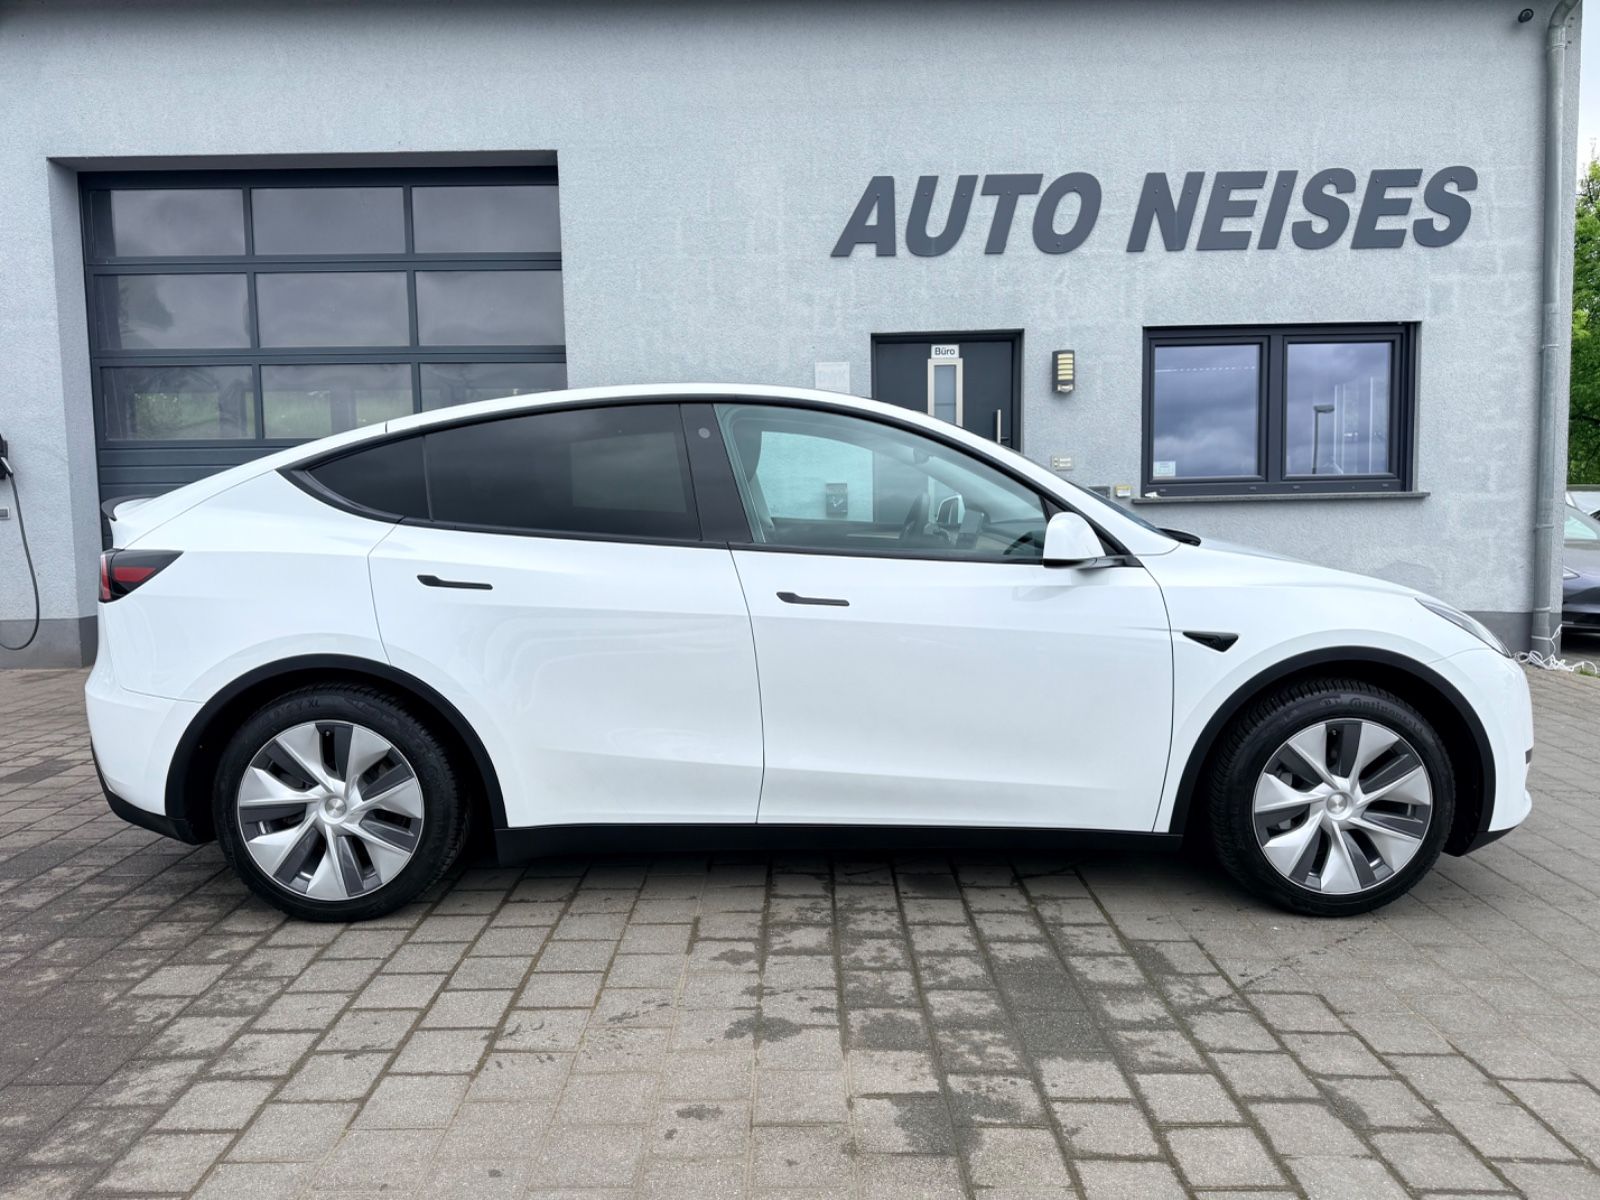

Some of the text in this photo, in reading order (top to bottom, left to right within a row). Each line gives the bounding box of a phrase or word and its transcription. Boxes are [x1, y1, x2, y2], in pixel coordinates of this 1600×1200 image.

[830, 165, 1478, 257] AUTO NEISES
[934, 346, 956, 356] Büro
